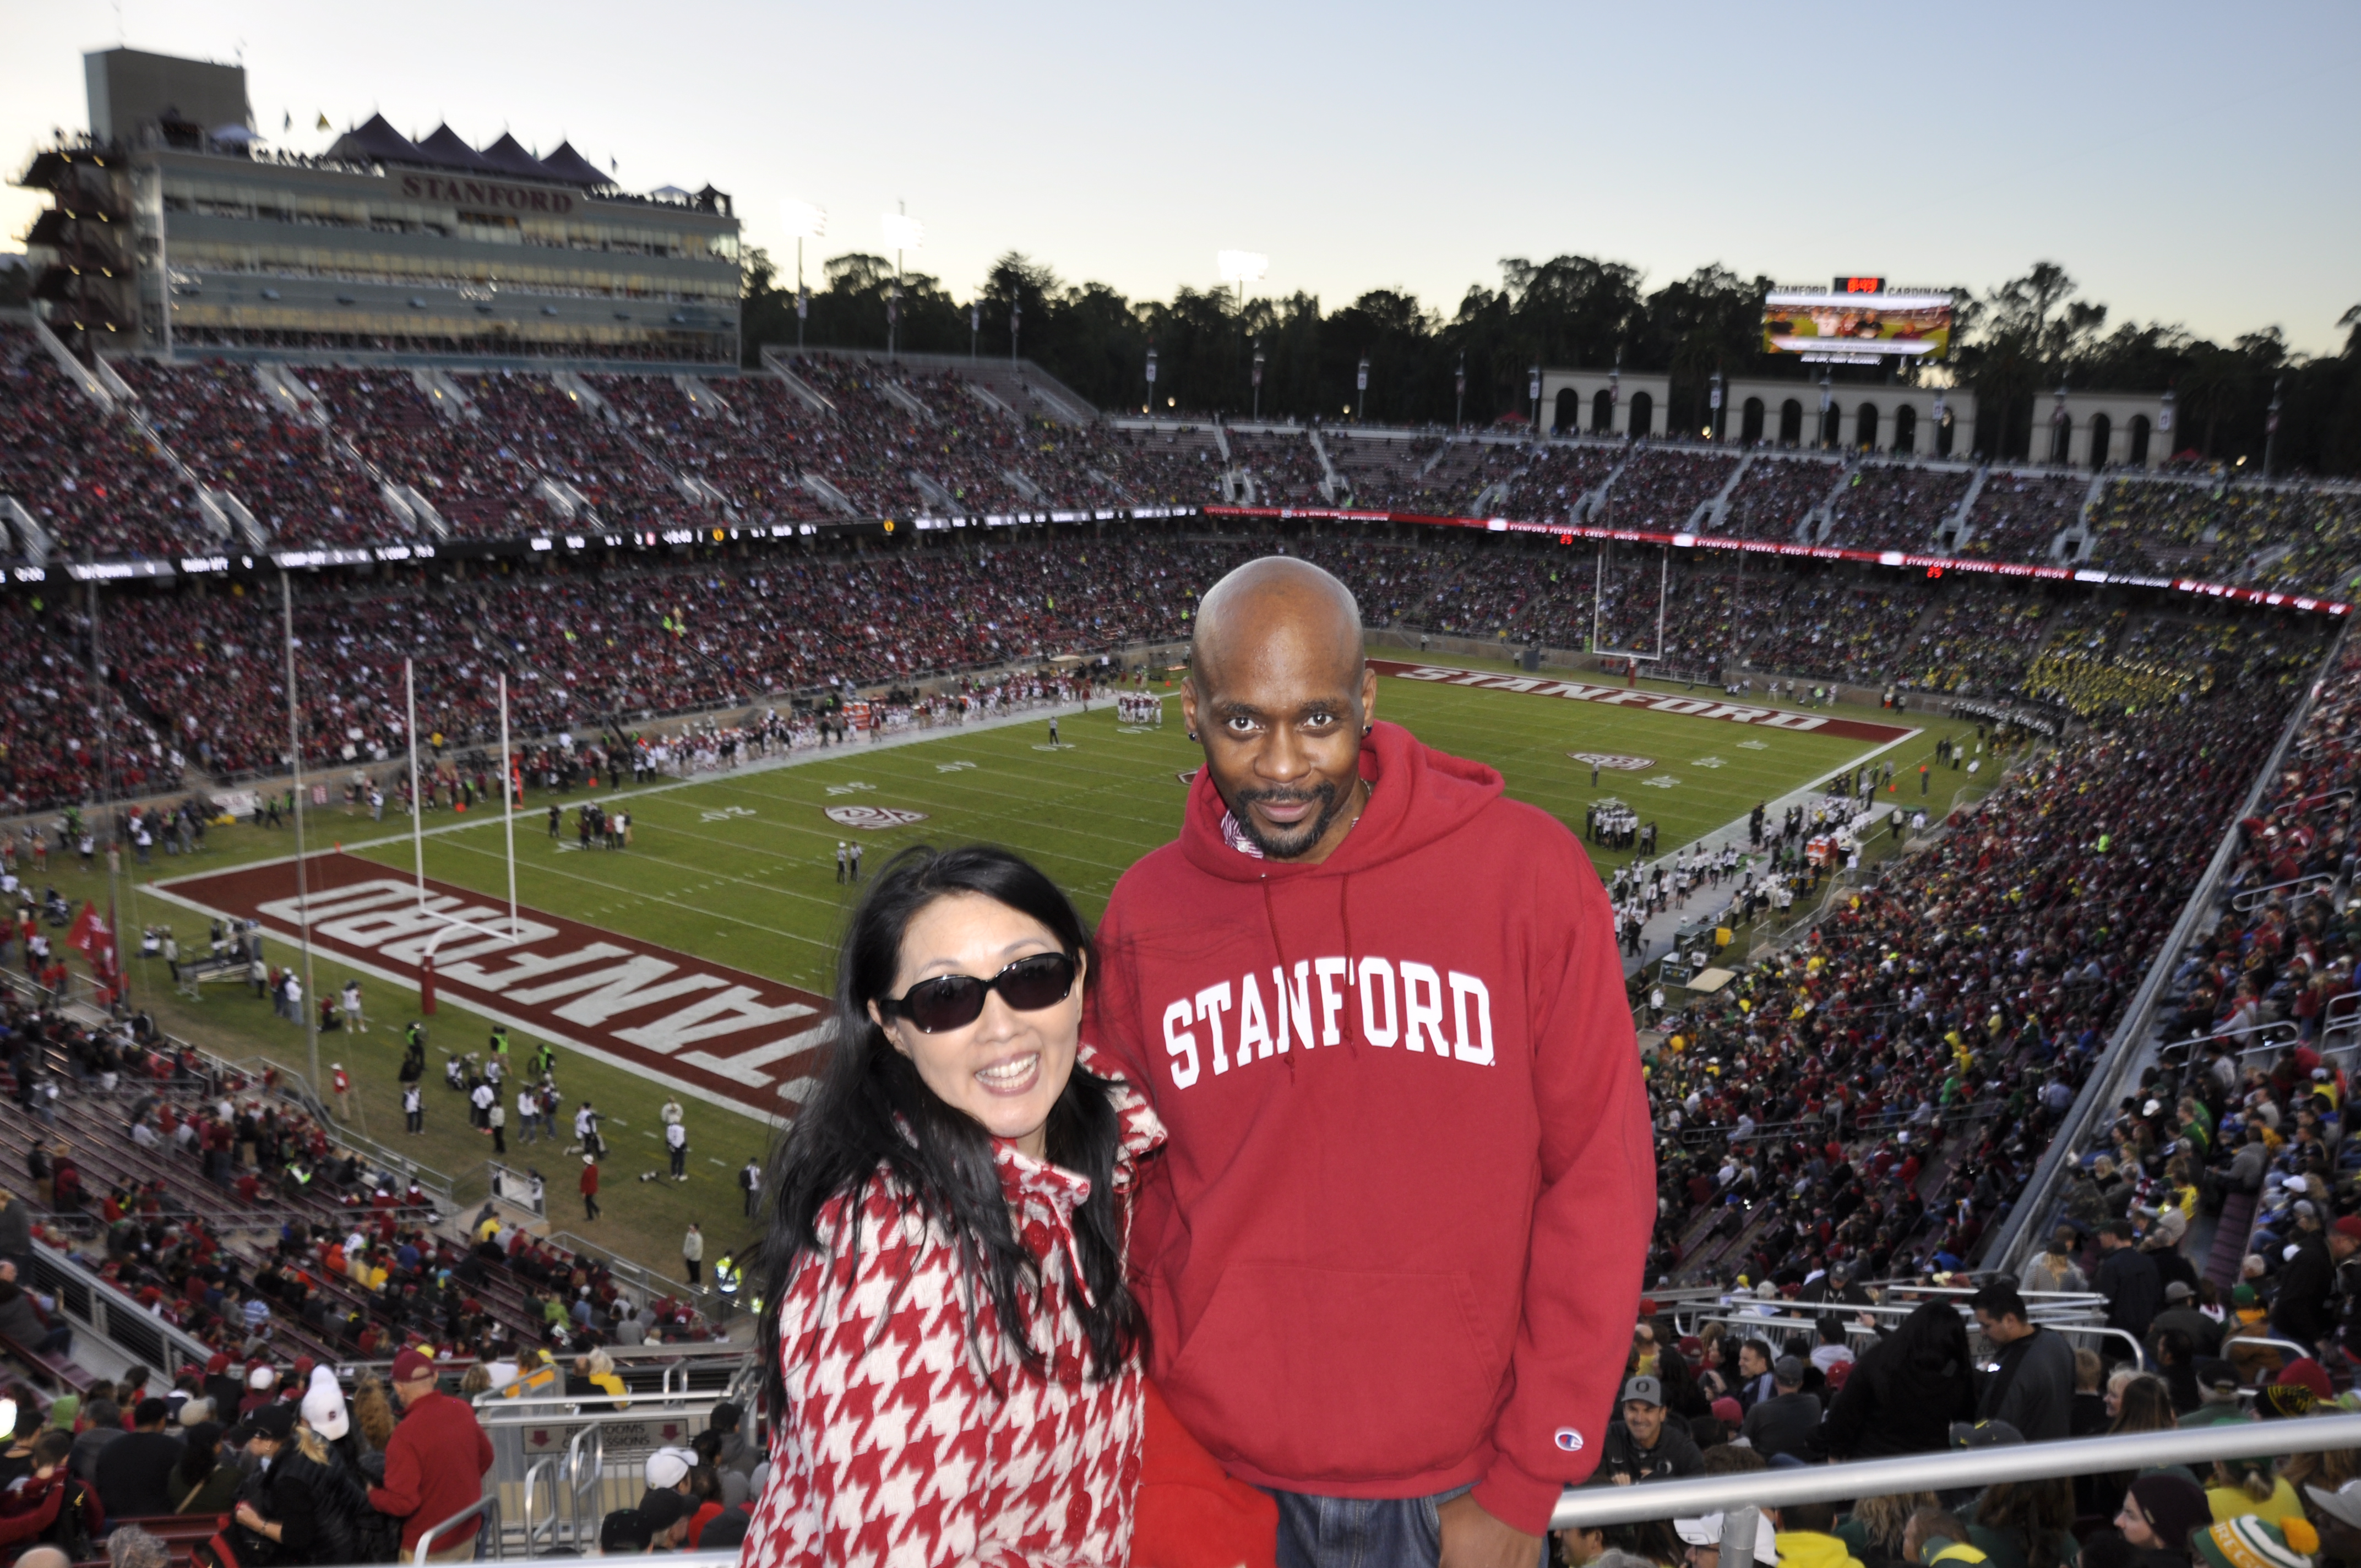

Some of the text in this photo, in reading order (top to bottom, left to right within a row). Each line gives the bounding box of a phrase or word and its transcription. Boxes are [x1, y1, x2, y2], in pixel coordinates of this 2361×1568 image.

[402, 175, 573, 215] STANFORD
[1509, 524, 1547, 533] STANFORD
[1549, 527, 1582, 537] FEDERAL
[1614, 533, 1640, 542] UNION
[1559, 534, 1573, 545] 25
[1696, 540, 1738, 550] STANFORD
[1779, 547, 1810, 556] CREDIT
[1812, 550, 1841, 559] UNION
[1906, 558, 1952, 569] STANFORD
[1955, 562, 1994, 573] FEDERAL
[1998, 567, 2031, 576] CREDIT
[2034, 569, 2066, 579] UNION
[1396, 667, 1829, 731] STANFORD
[257, 878, 840, 1103] TANFORD
[1162, 955, 1494, 1090] STANFORD
